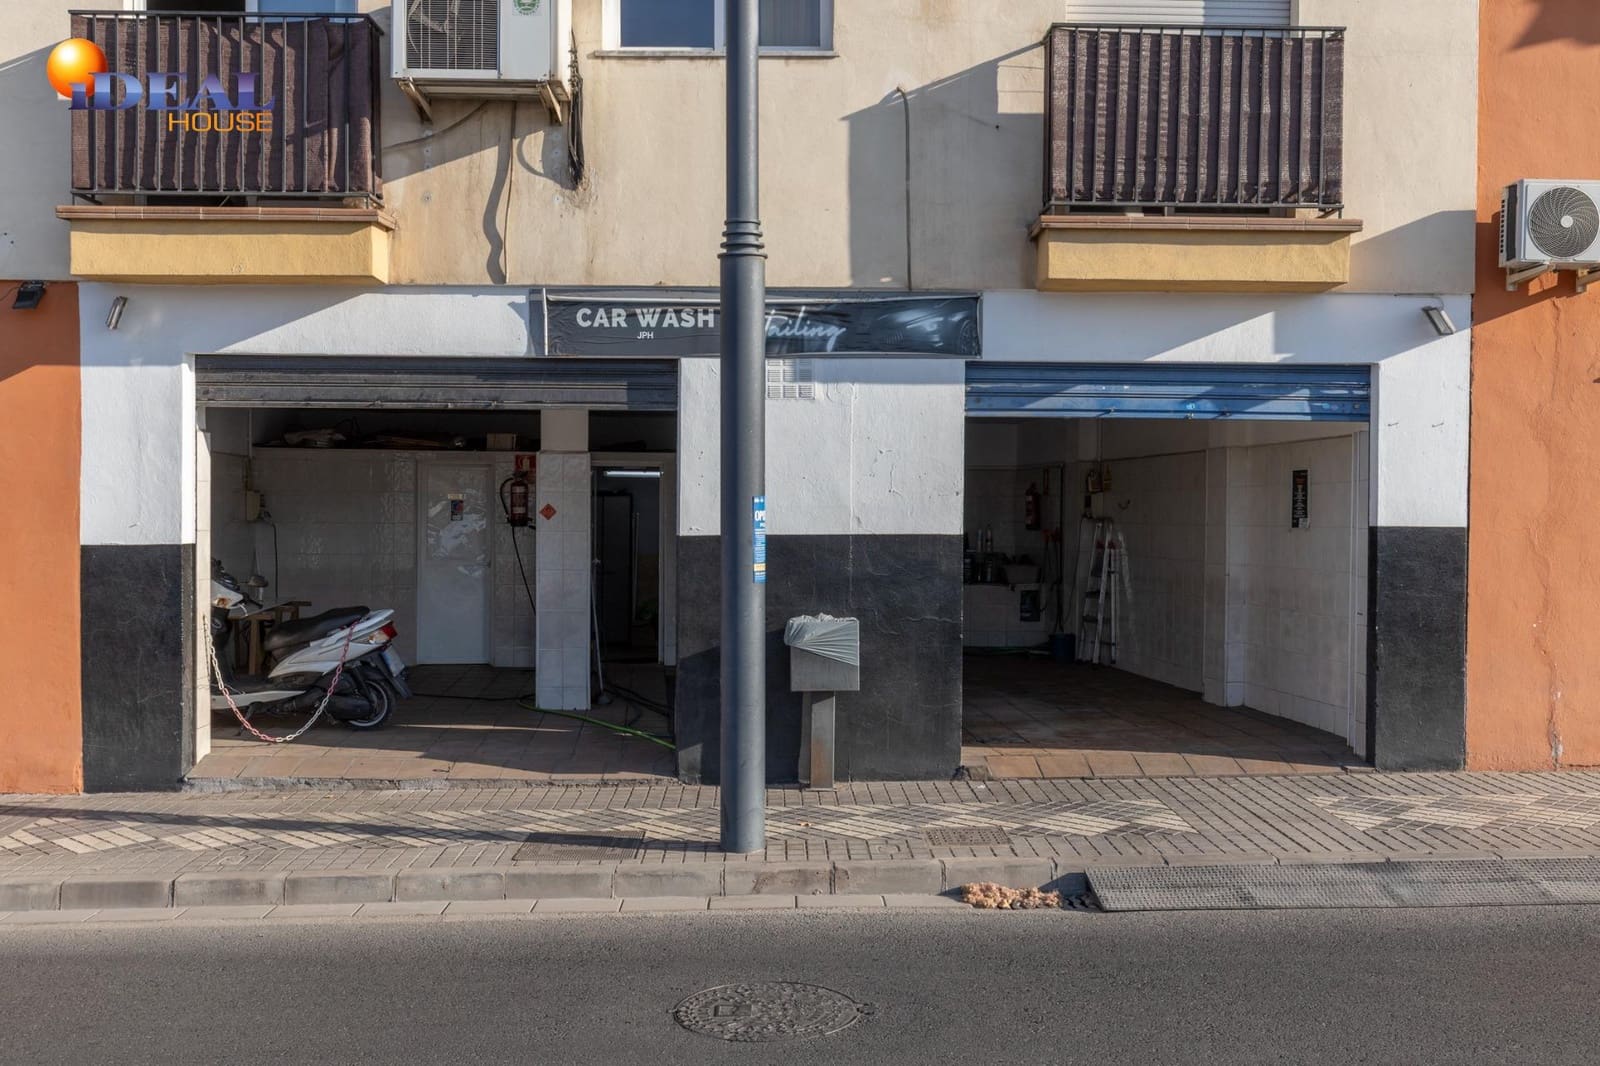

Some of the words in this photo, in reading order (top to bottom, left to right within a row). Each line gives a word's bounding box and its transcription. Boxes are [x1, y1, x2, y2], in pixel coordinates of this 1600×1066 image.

[575, 307, 628, 328] CAR
[635, 307, 715, 328] WASH
[636, 331, 654, 340] JPH
